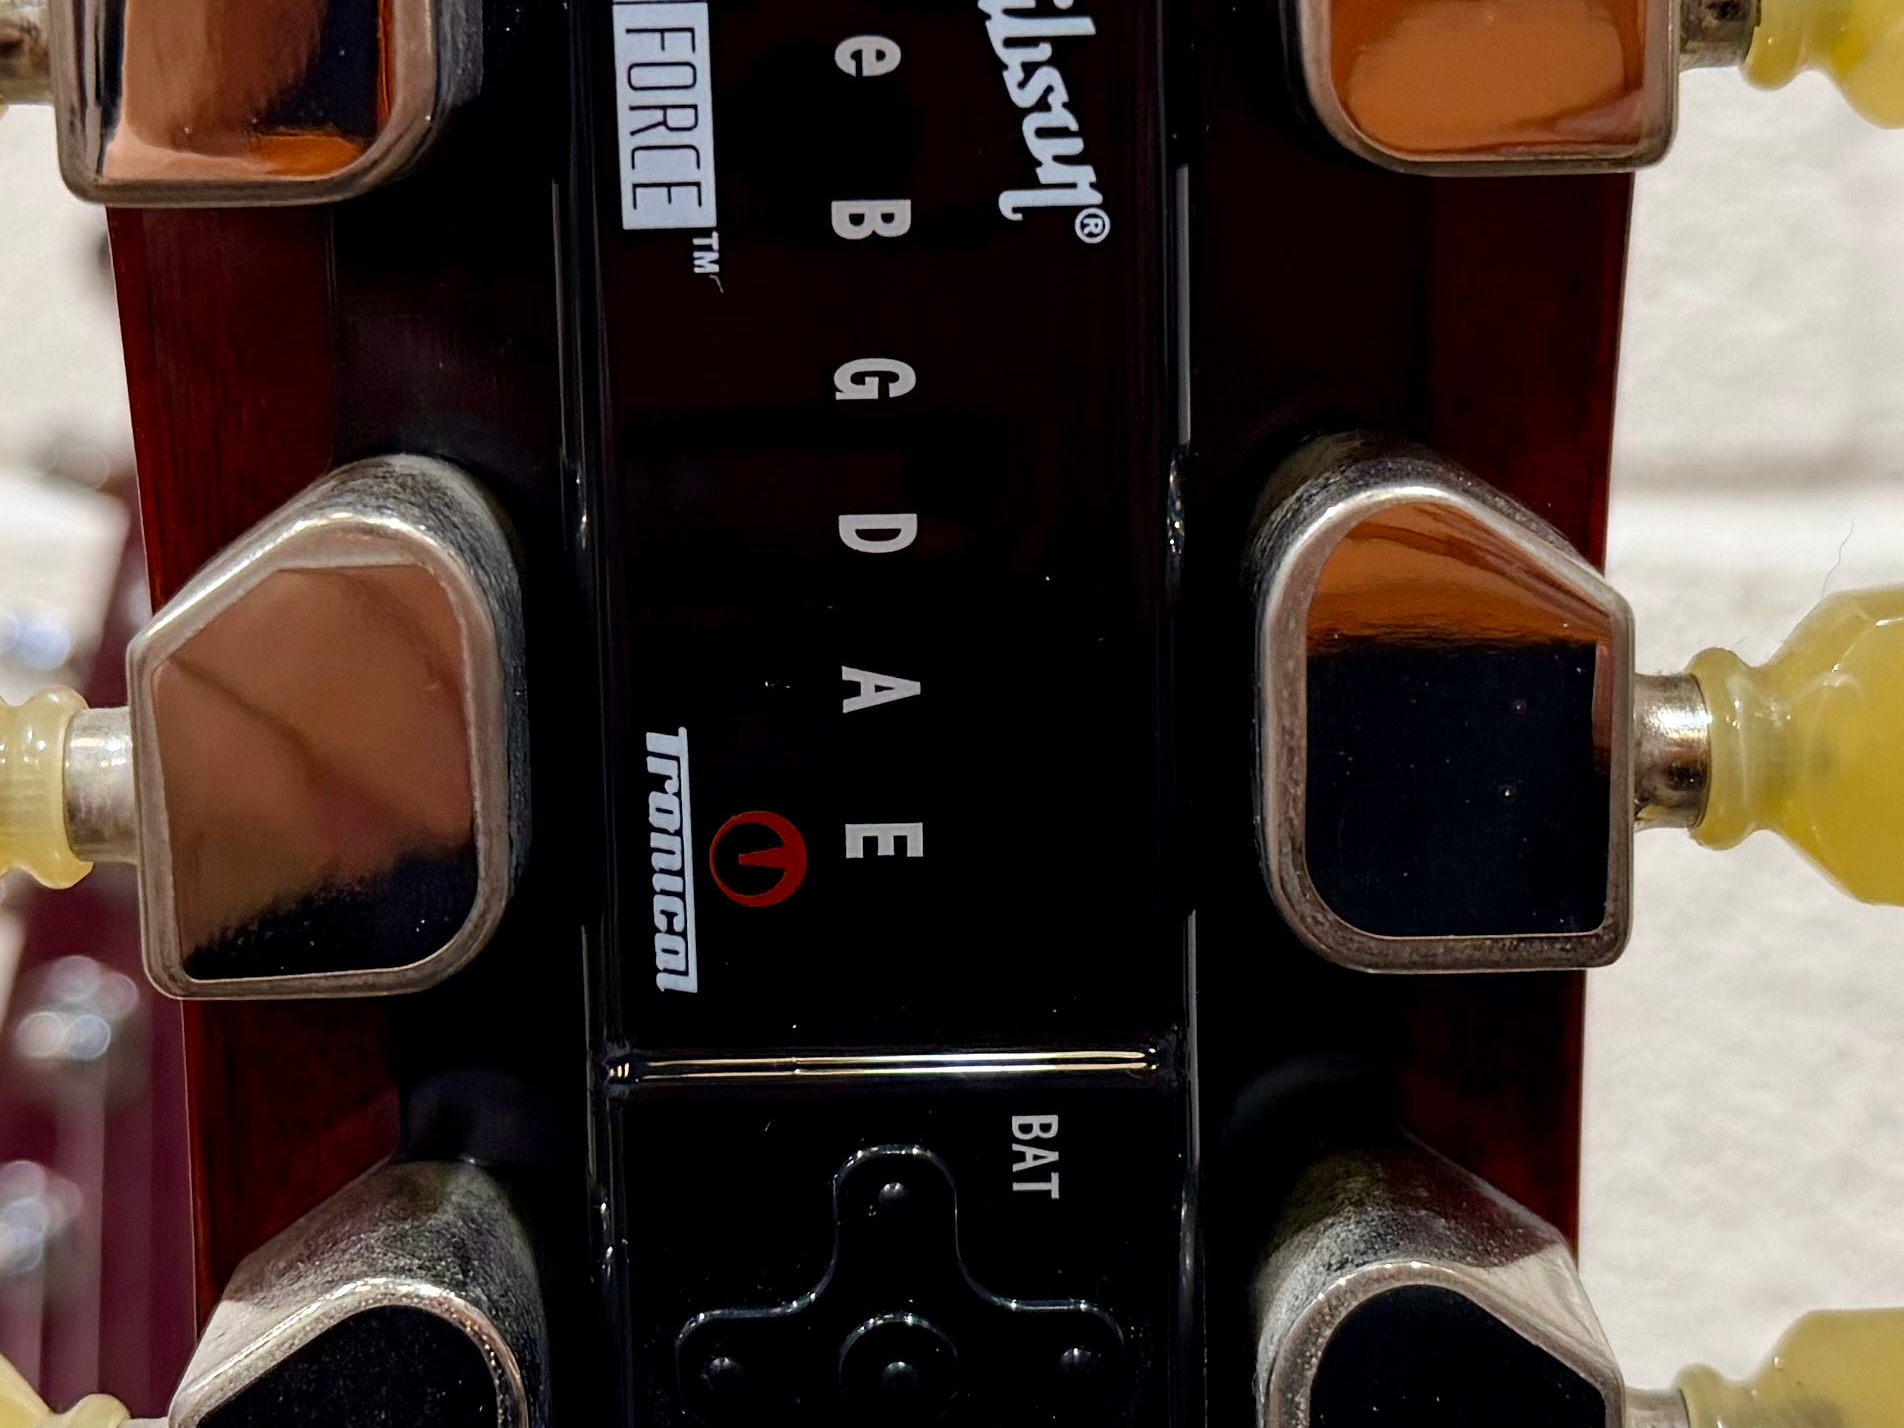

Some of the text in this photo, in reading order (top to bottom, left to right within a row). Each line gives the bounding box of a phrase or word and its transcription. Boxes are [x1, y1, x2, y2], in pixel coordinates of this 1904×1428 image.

[831, 35, 924, 859] e B G D A E
[646, 726, 698, 993] Tronical
[1011, 1114, 1060, 1199] BAT
